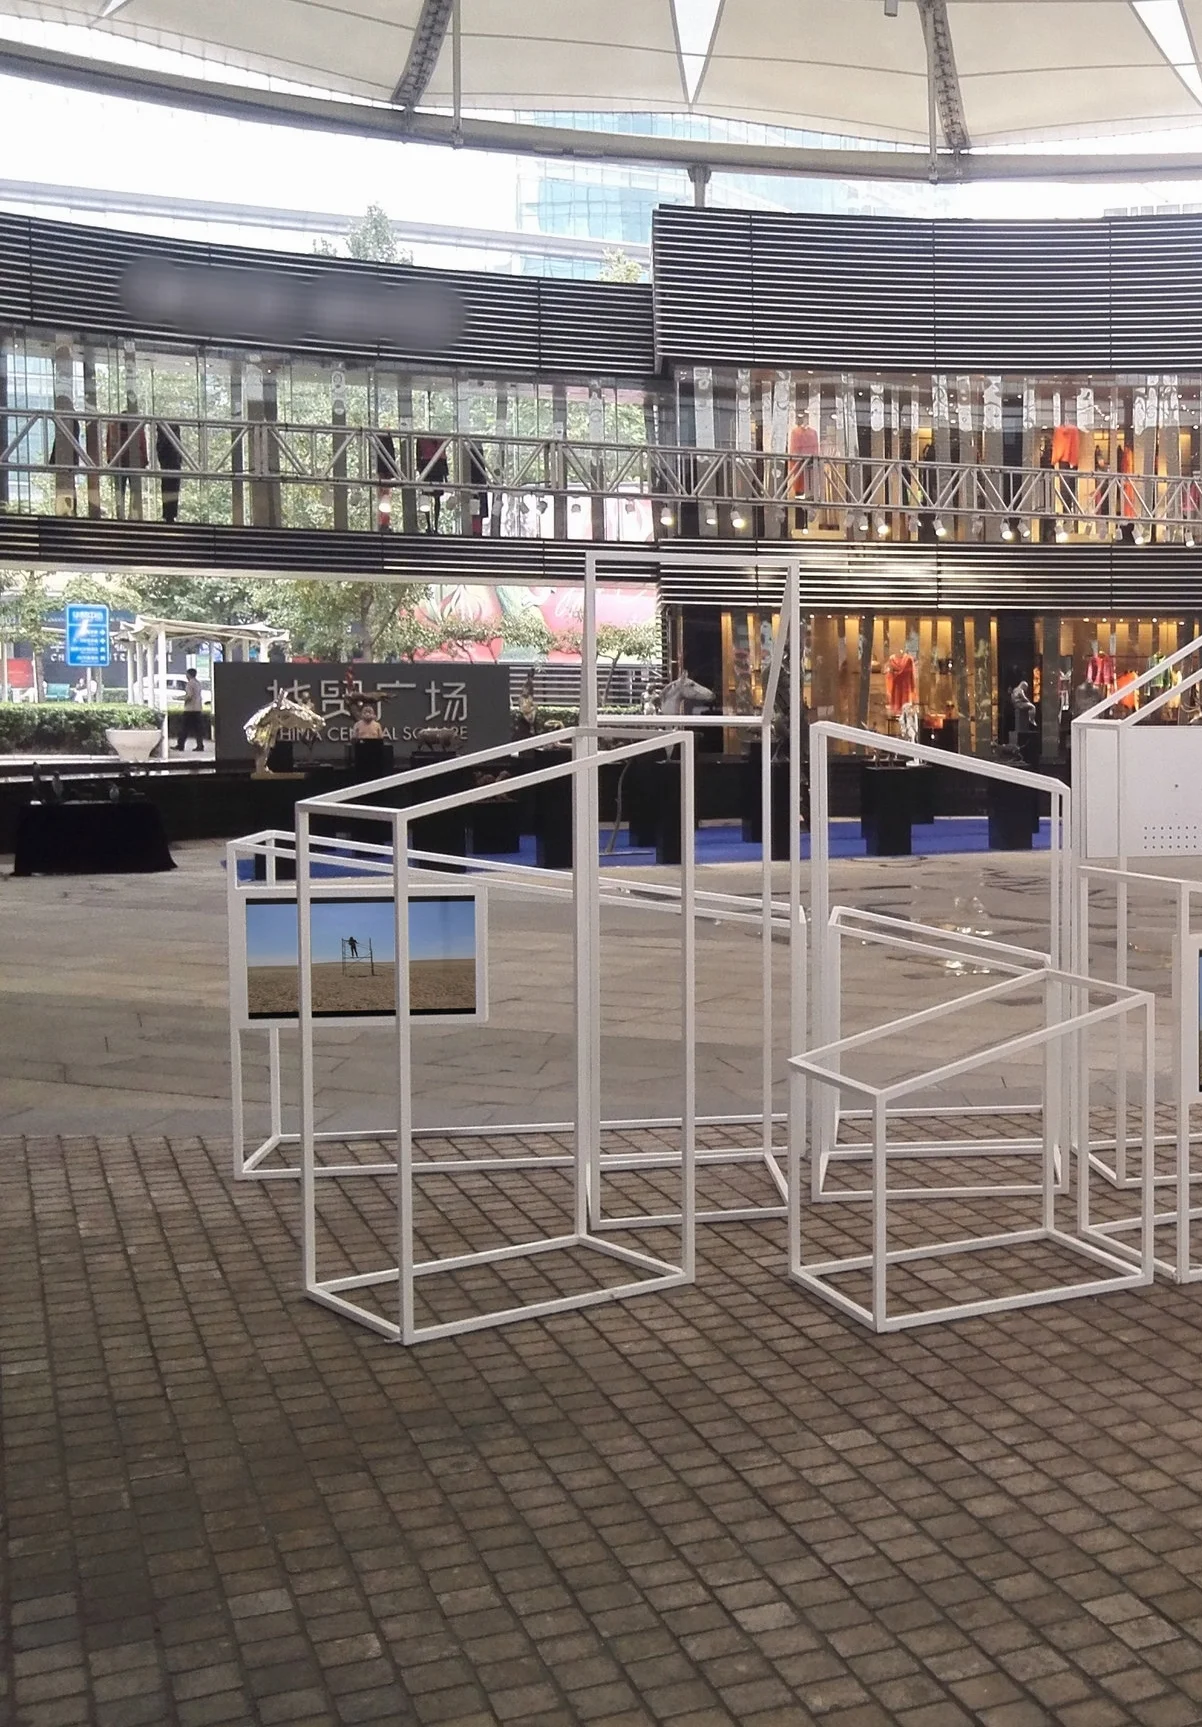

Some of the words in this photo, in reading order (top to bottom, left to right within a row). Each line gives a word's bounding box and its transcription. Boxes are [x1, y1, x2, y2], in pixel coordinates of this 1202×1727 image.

[274, 727, 323, 741] HINA
[327, 726, 399, 741] CEAL
[403, 726, 468, 741] SQRE
